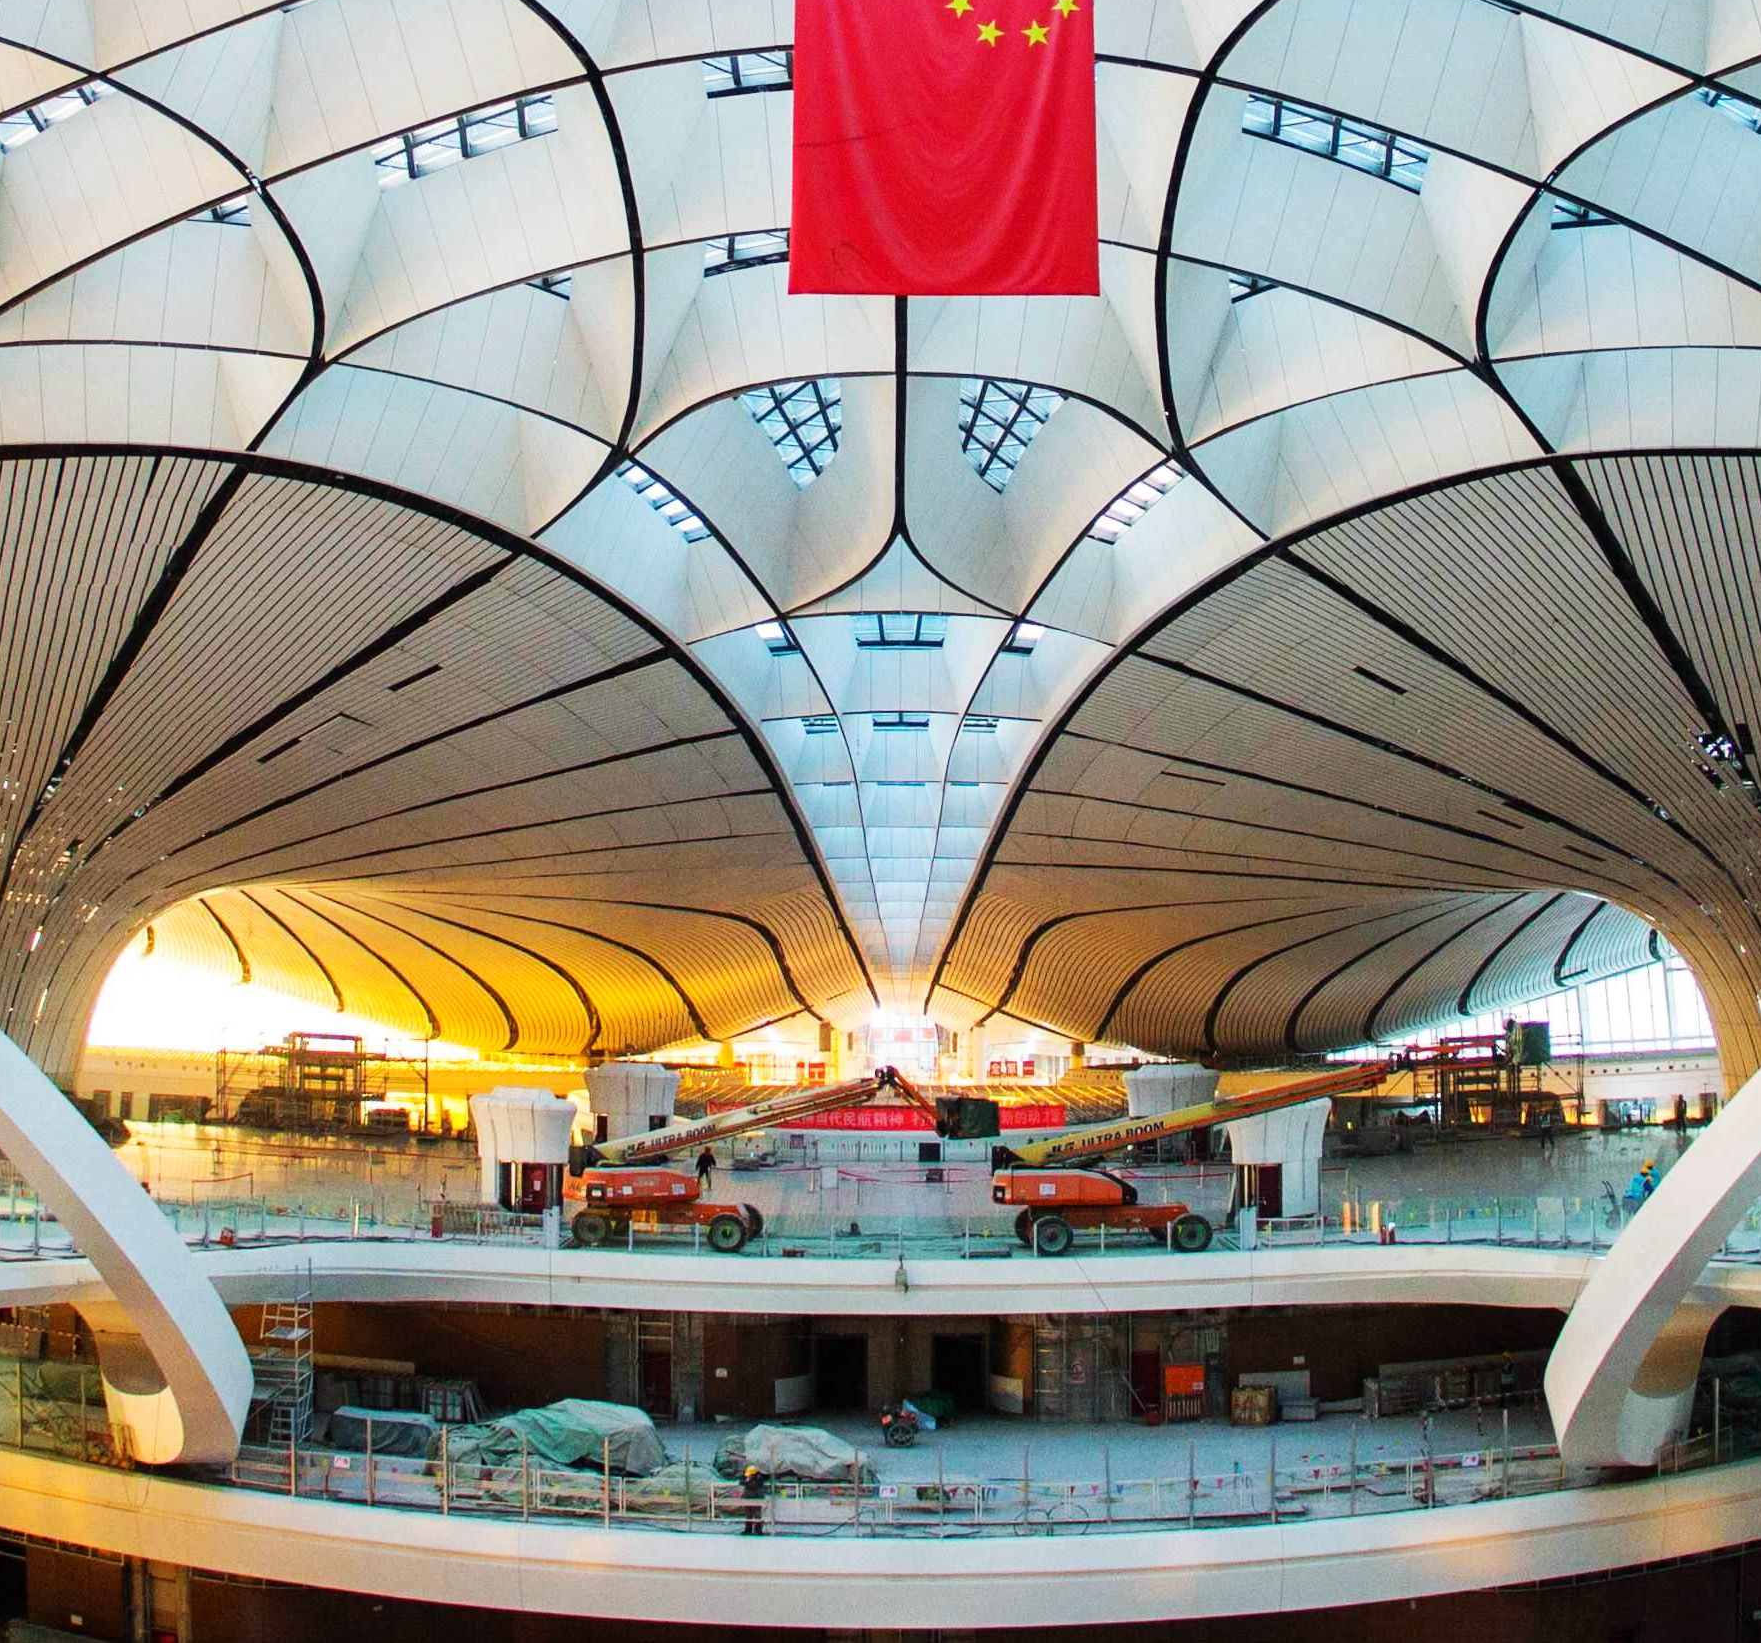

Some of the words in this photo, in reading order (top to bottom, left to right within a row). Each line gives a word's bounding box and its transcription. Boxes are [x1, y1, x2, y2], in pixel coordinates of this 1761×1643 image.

[651, 1131, 683, 1148] ULTRA
[685, 1123, 717, 1140] BOOM
[1082, 1131, 1122, 1148] ULTRA
[1125, 1121, 1165, 1138] BOOM
